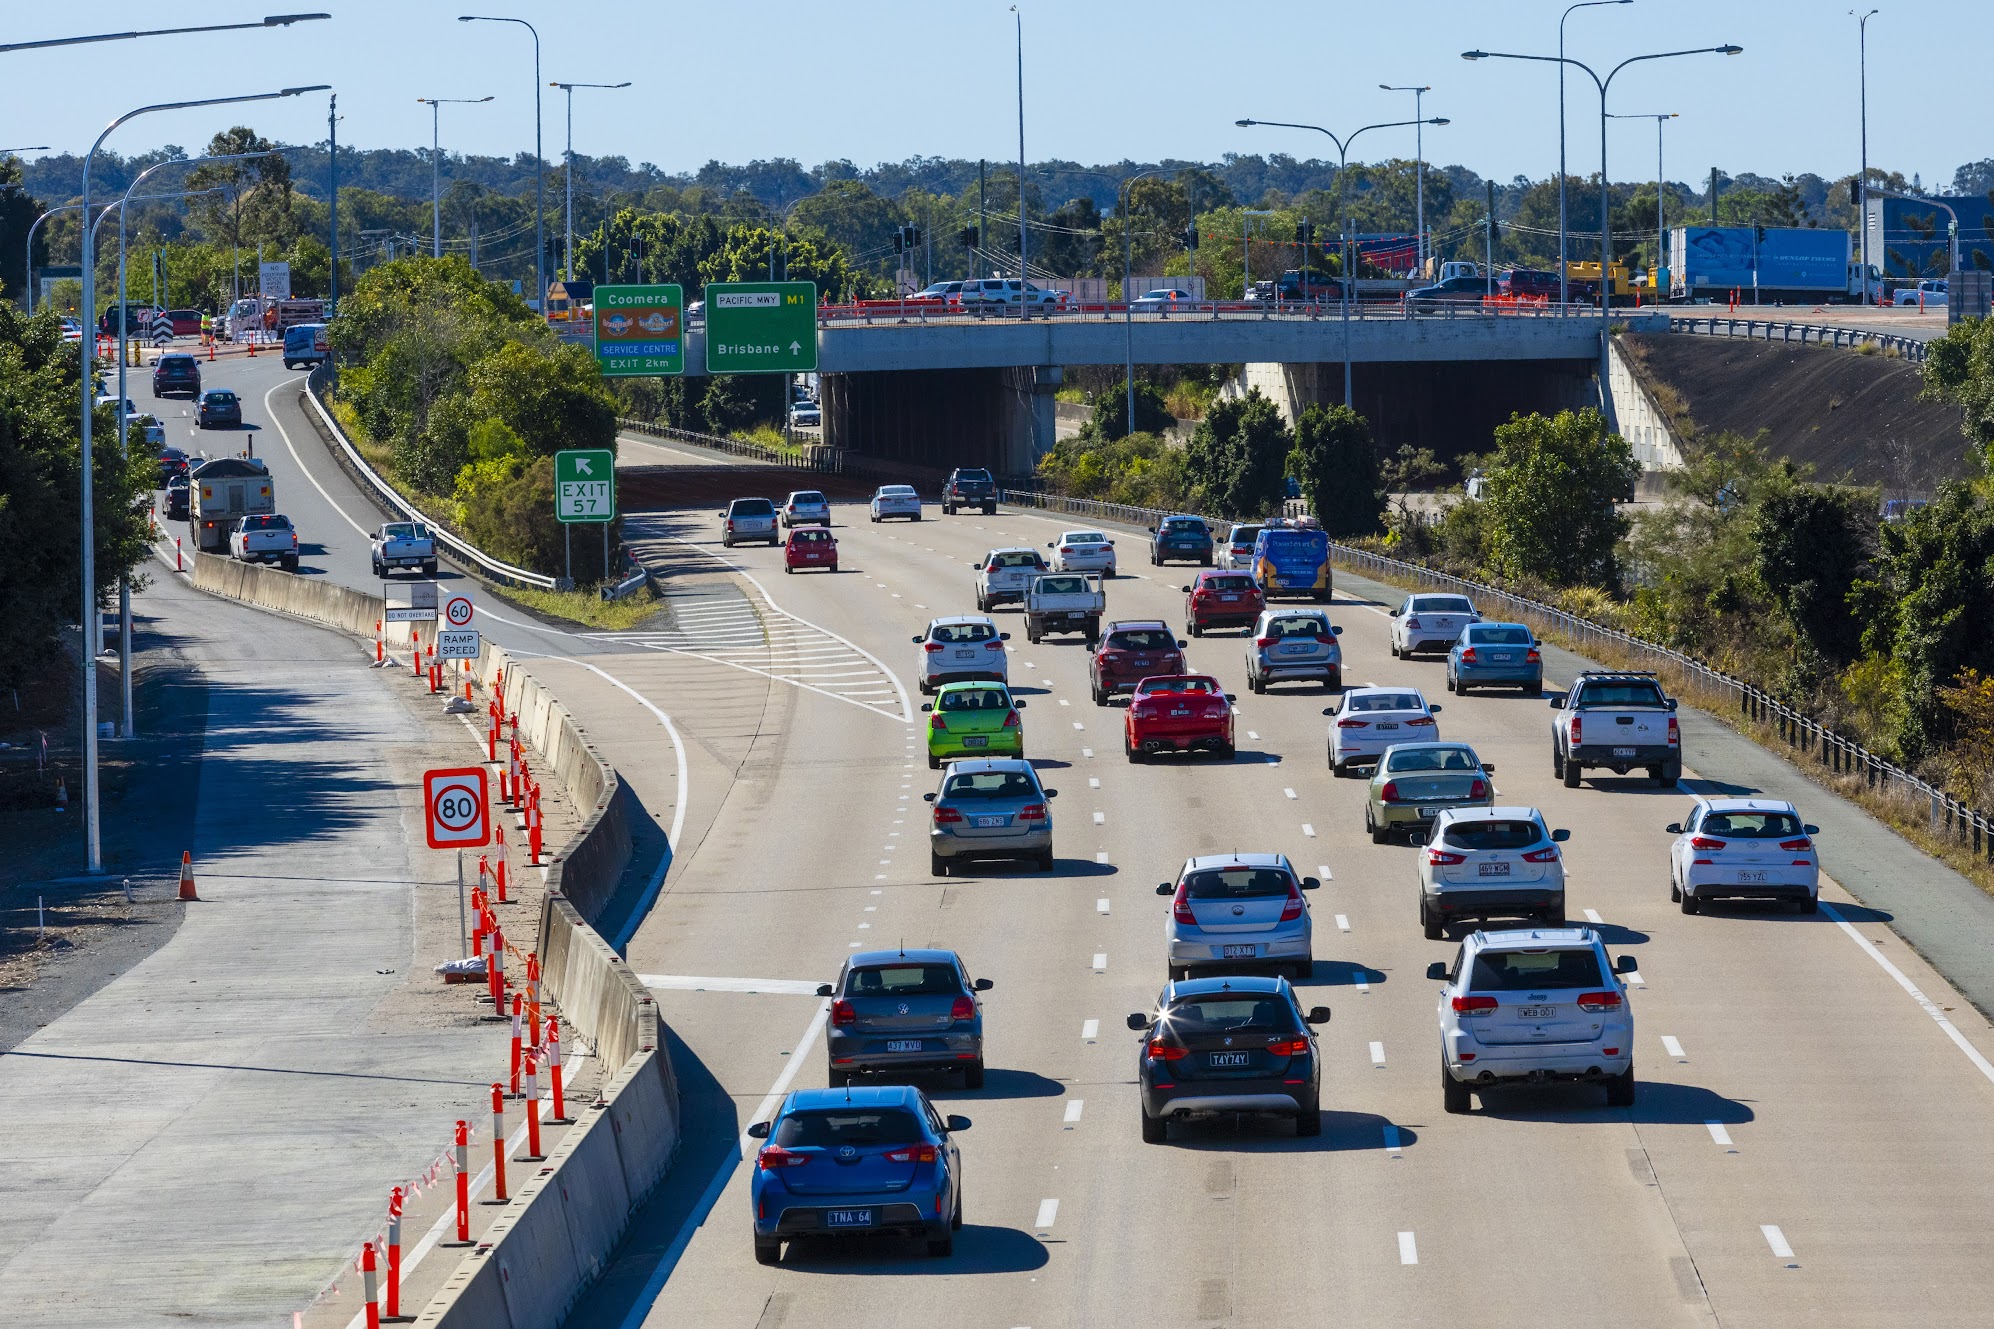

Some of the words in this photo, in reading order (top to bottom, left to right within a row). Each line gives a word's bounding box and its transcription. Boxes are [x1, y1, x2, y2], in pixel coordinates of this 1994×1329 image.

[608, 294, 668, 304] Coomera
[719, 296, 753, 306] PACIFIC
[756, 295, 778, 304] MWY
[787, 295, 804, 305] M1
[604, 346, 639, 354] SERVICE
[644, 344, 676, 354] CENTRE
[718, 344, 780, 355] Brisbane
[610, 359, 638, 368] EXIT
[646, 358, 668, 368] 2km
[562, 483, 606, 497] EXIT
[574, 500, 597, 513] 57
[451, 606, 468, 618] 60
[444, 636, 474, 644] RAMP
[442, 646, 476, 655] SPEED
[442, 798, 472, 819] 80
[1754, 872, 1766, 881] YZL
[1239, 946, 1254, 954] XTY
[1528, 994, 1548, 1002] Jeep
[1523, 1008, 1538, 1017] WEB
[1213, 1054, 1246, 1066] T4Y74Y
[832, 1212, 853, 1223] TNA
[858, 1211, 870, 1222] 64
